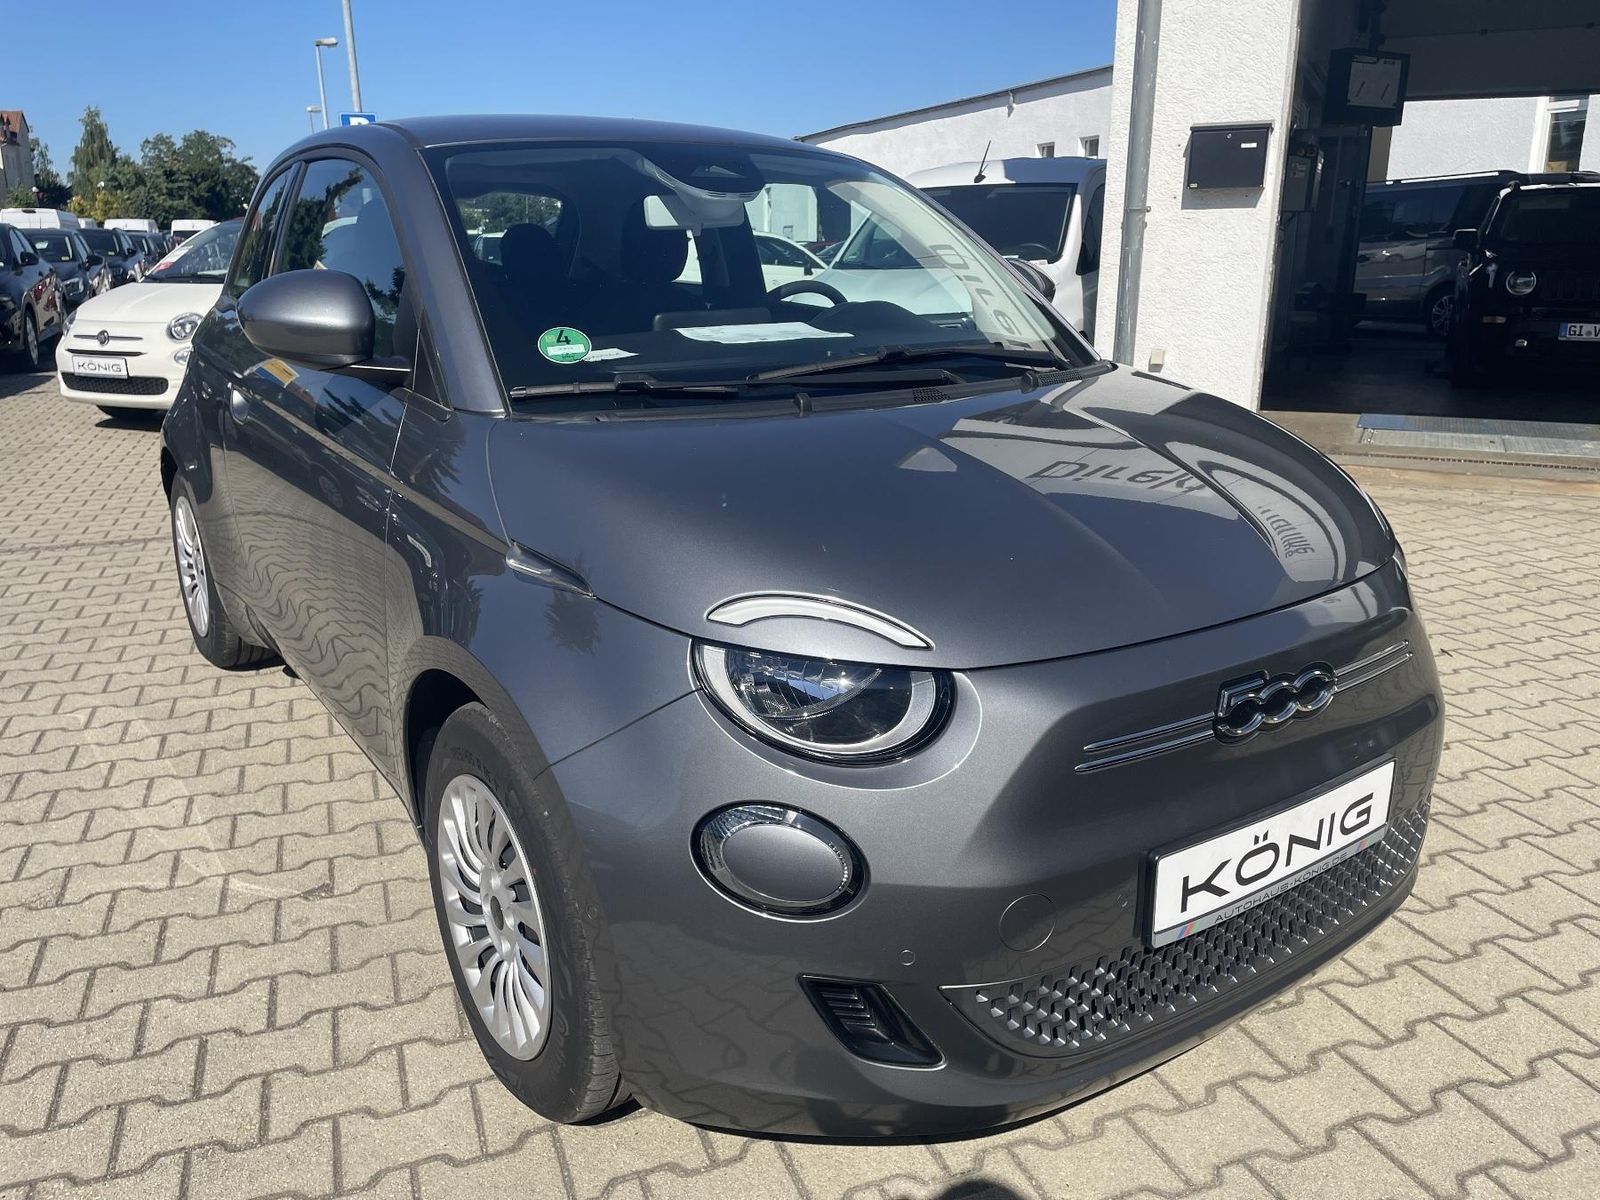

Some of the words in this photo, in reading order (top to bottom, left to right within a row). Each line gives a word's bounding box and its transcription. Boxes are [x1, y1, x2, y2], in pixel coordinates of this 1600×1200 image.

[556, 329, 571, 345] 4
[1568, 325, 1584, 337] GI
[77, 360, 121, 373] KÖNIG
[1214, 666, 1336, 741] 500
[1180, 792, 1375, 914] KÖNIG
